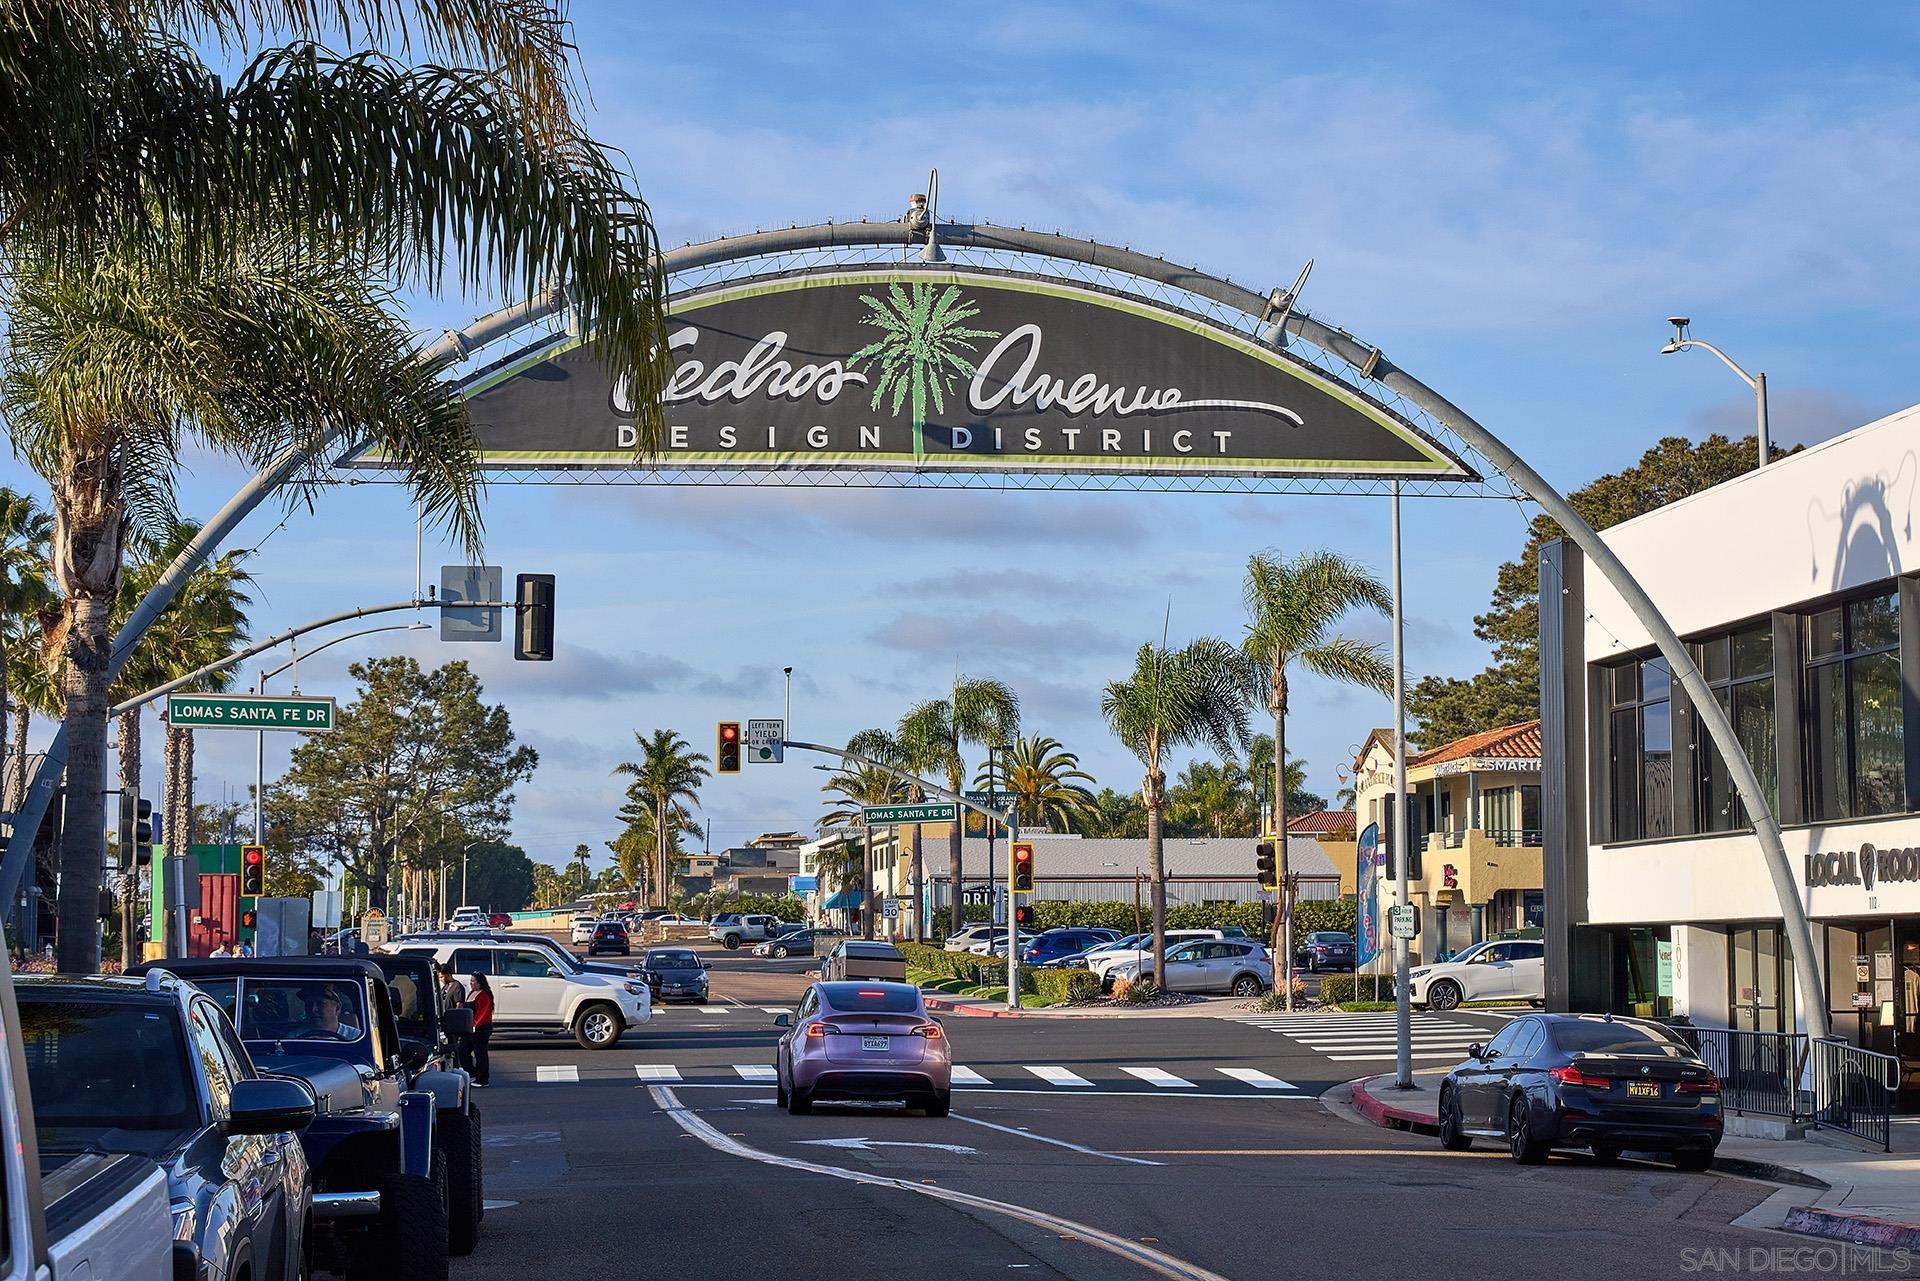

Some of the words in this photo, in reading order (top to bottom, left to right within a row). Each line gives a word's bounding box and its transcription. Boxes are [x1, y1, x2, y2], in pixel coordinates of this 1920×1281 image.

[968, 323, 1305, 426] Avenue
[617, 425, 881, 448] DESIGN
[952, 427, 1232, 453] DISTRICT
[174, 705, 223, 718] LOMAS
[230, 707, 277, 720] SANTA
[283, 708, 300, 721] FE
[307, 709, 326, 722] DR
[754, 730, 778, 738] YIELD
[865, 810, 894, 820] LOMAS
[897, 809, 925, 818] SANTA
[928, 809, 939, 817] FE
[942, 808, 953, 816] DR
[1805, 851, 1861, 887] LOCAL
[884, 908, 898, 916] 30
[1393, 906, 1400, 915] 3
